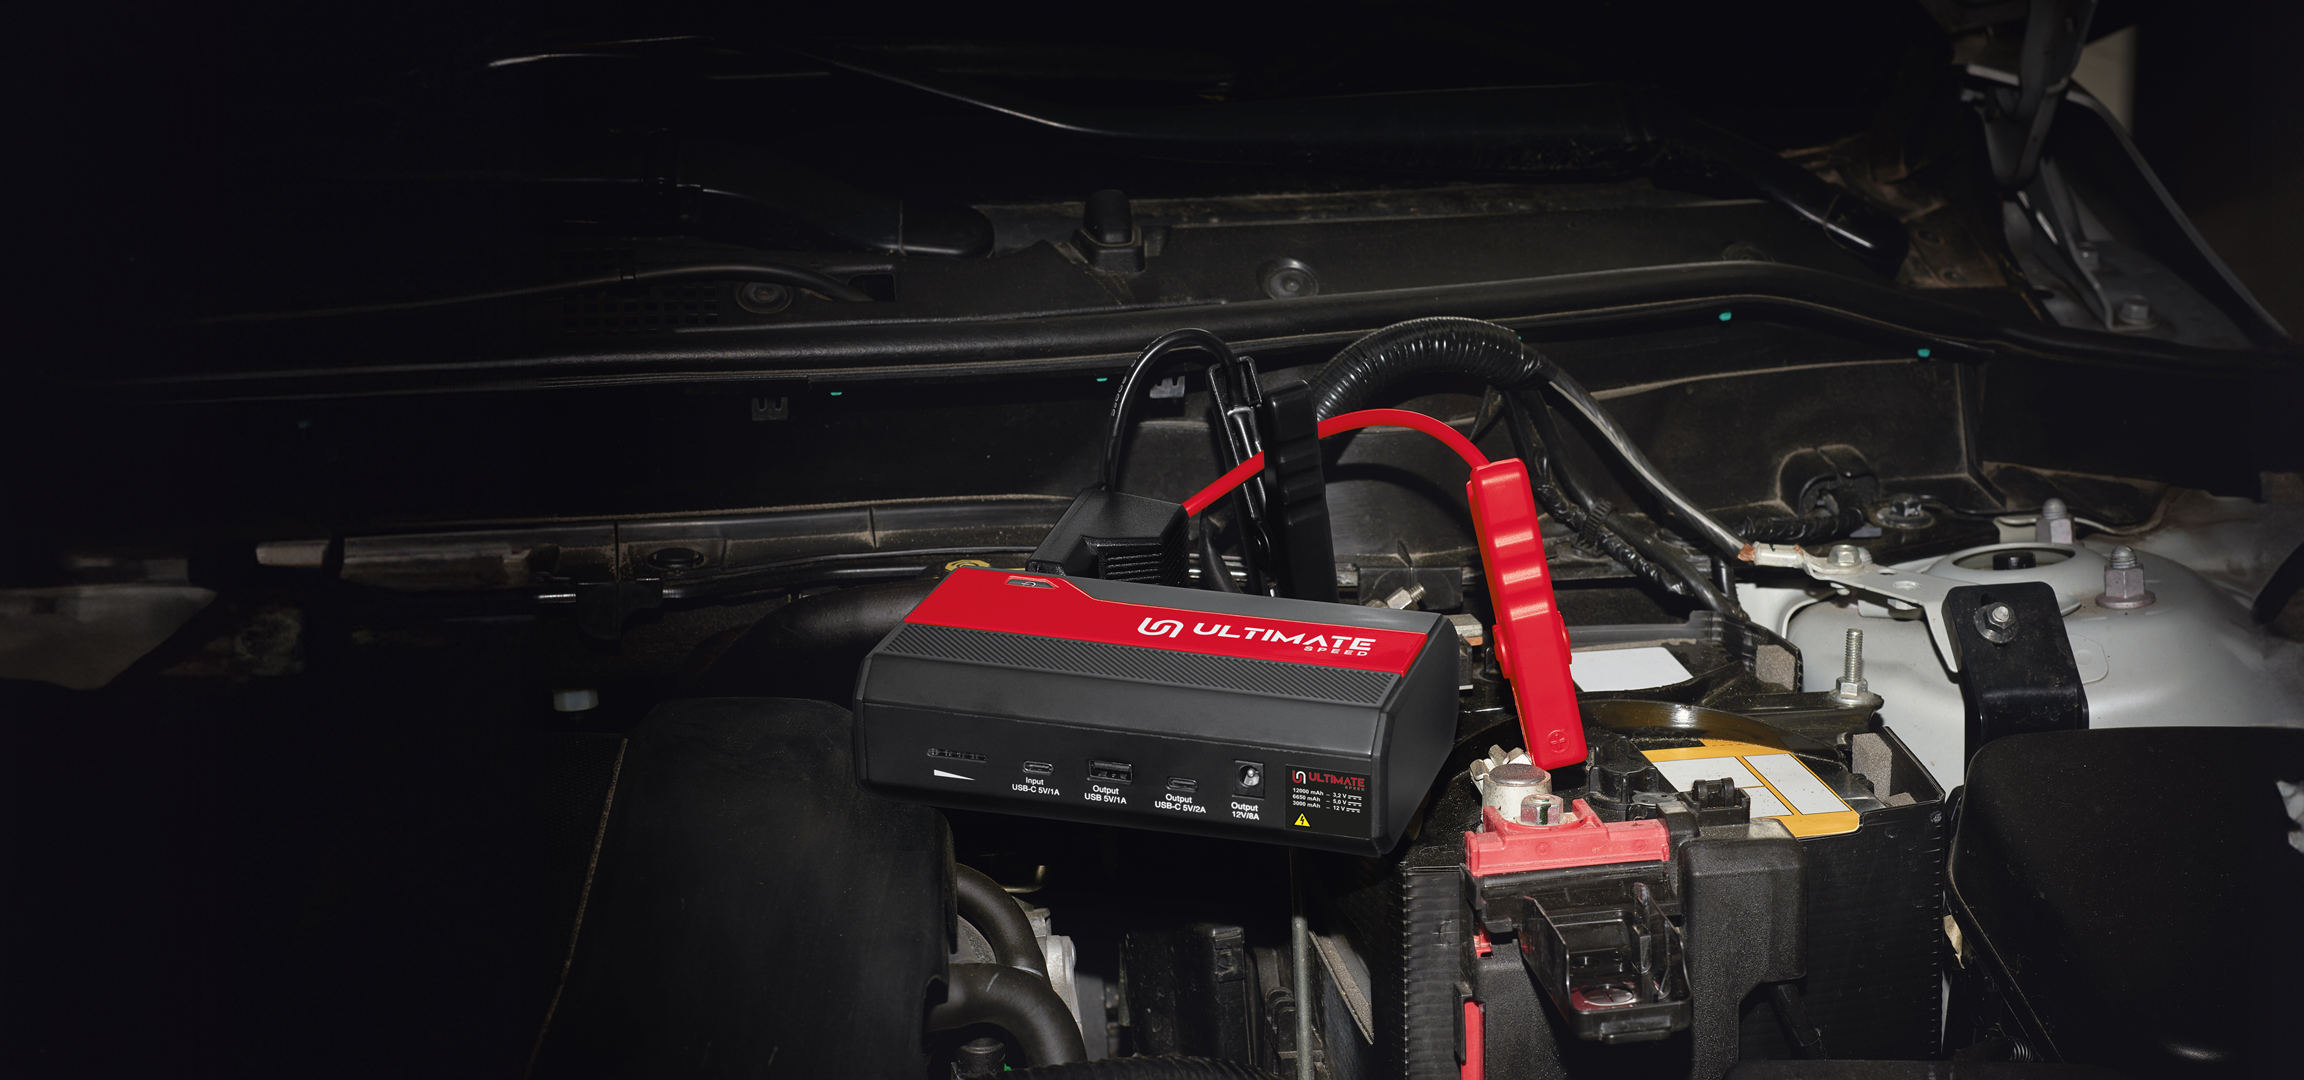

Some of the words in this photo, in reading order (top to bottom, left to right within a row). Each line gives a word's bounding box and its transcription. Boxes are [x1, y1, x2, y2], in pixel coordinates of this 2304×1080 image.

[1193, 622, 1376, 651] ULTIMATE
[1303, 646, 1368, 657] SPEED
[1025, 777, 1044, 785] Input
[1308, 772, 1365, 787] ULTIMATE
[1012, 783, 1037, 793] USB-C
[1038, 786, 1060, 796] 5V/1A
[1092, 785, 1119, 795] Output
[1084, 793, 1102, 801] USB
[1103, 795, 1127, 804] 5V/1A
[1165, 793, 1192, 804] Output
[1154, 800, 1181, 810] USB-C
[1182, 804, 1207, 814] 5V/2A
[1230, 801, 1259, 812] Output
[1231, 811, 1260, 820] 12V/8A
